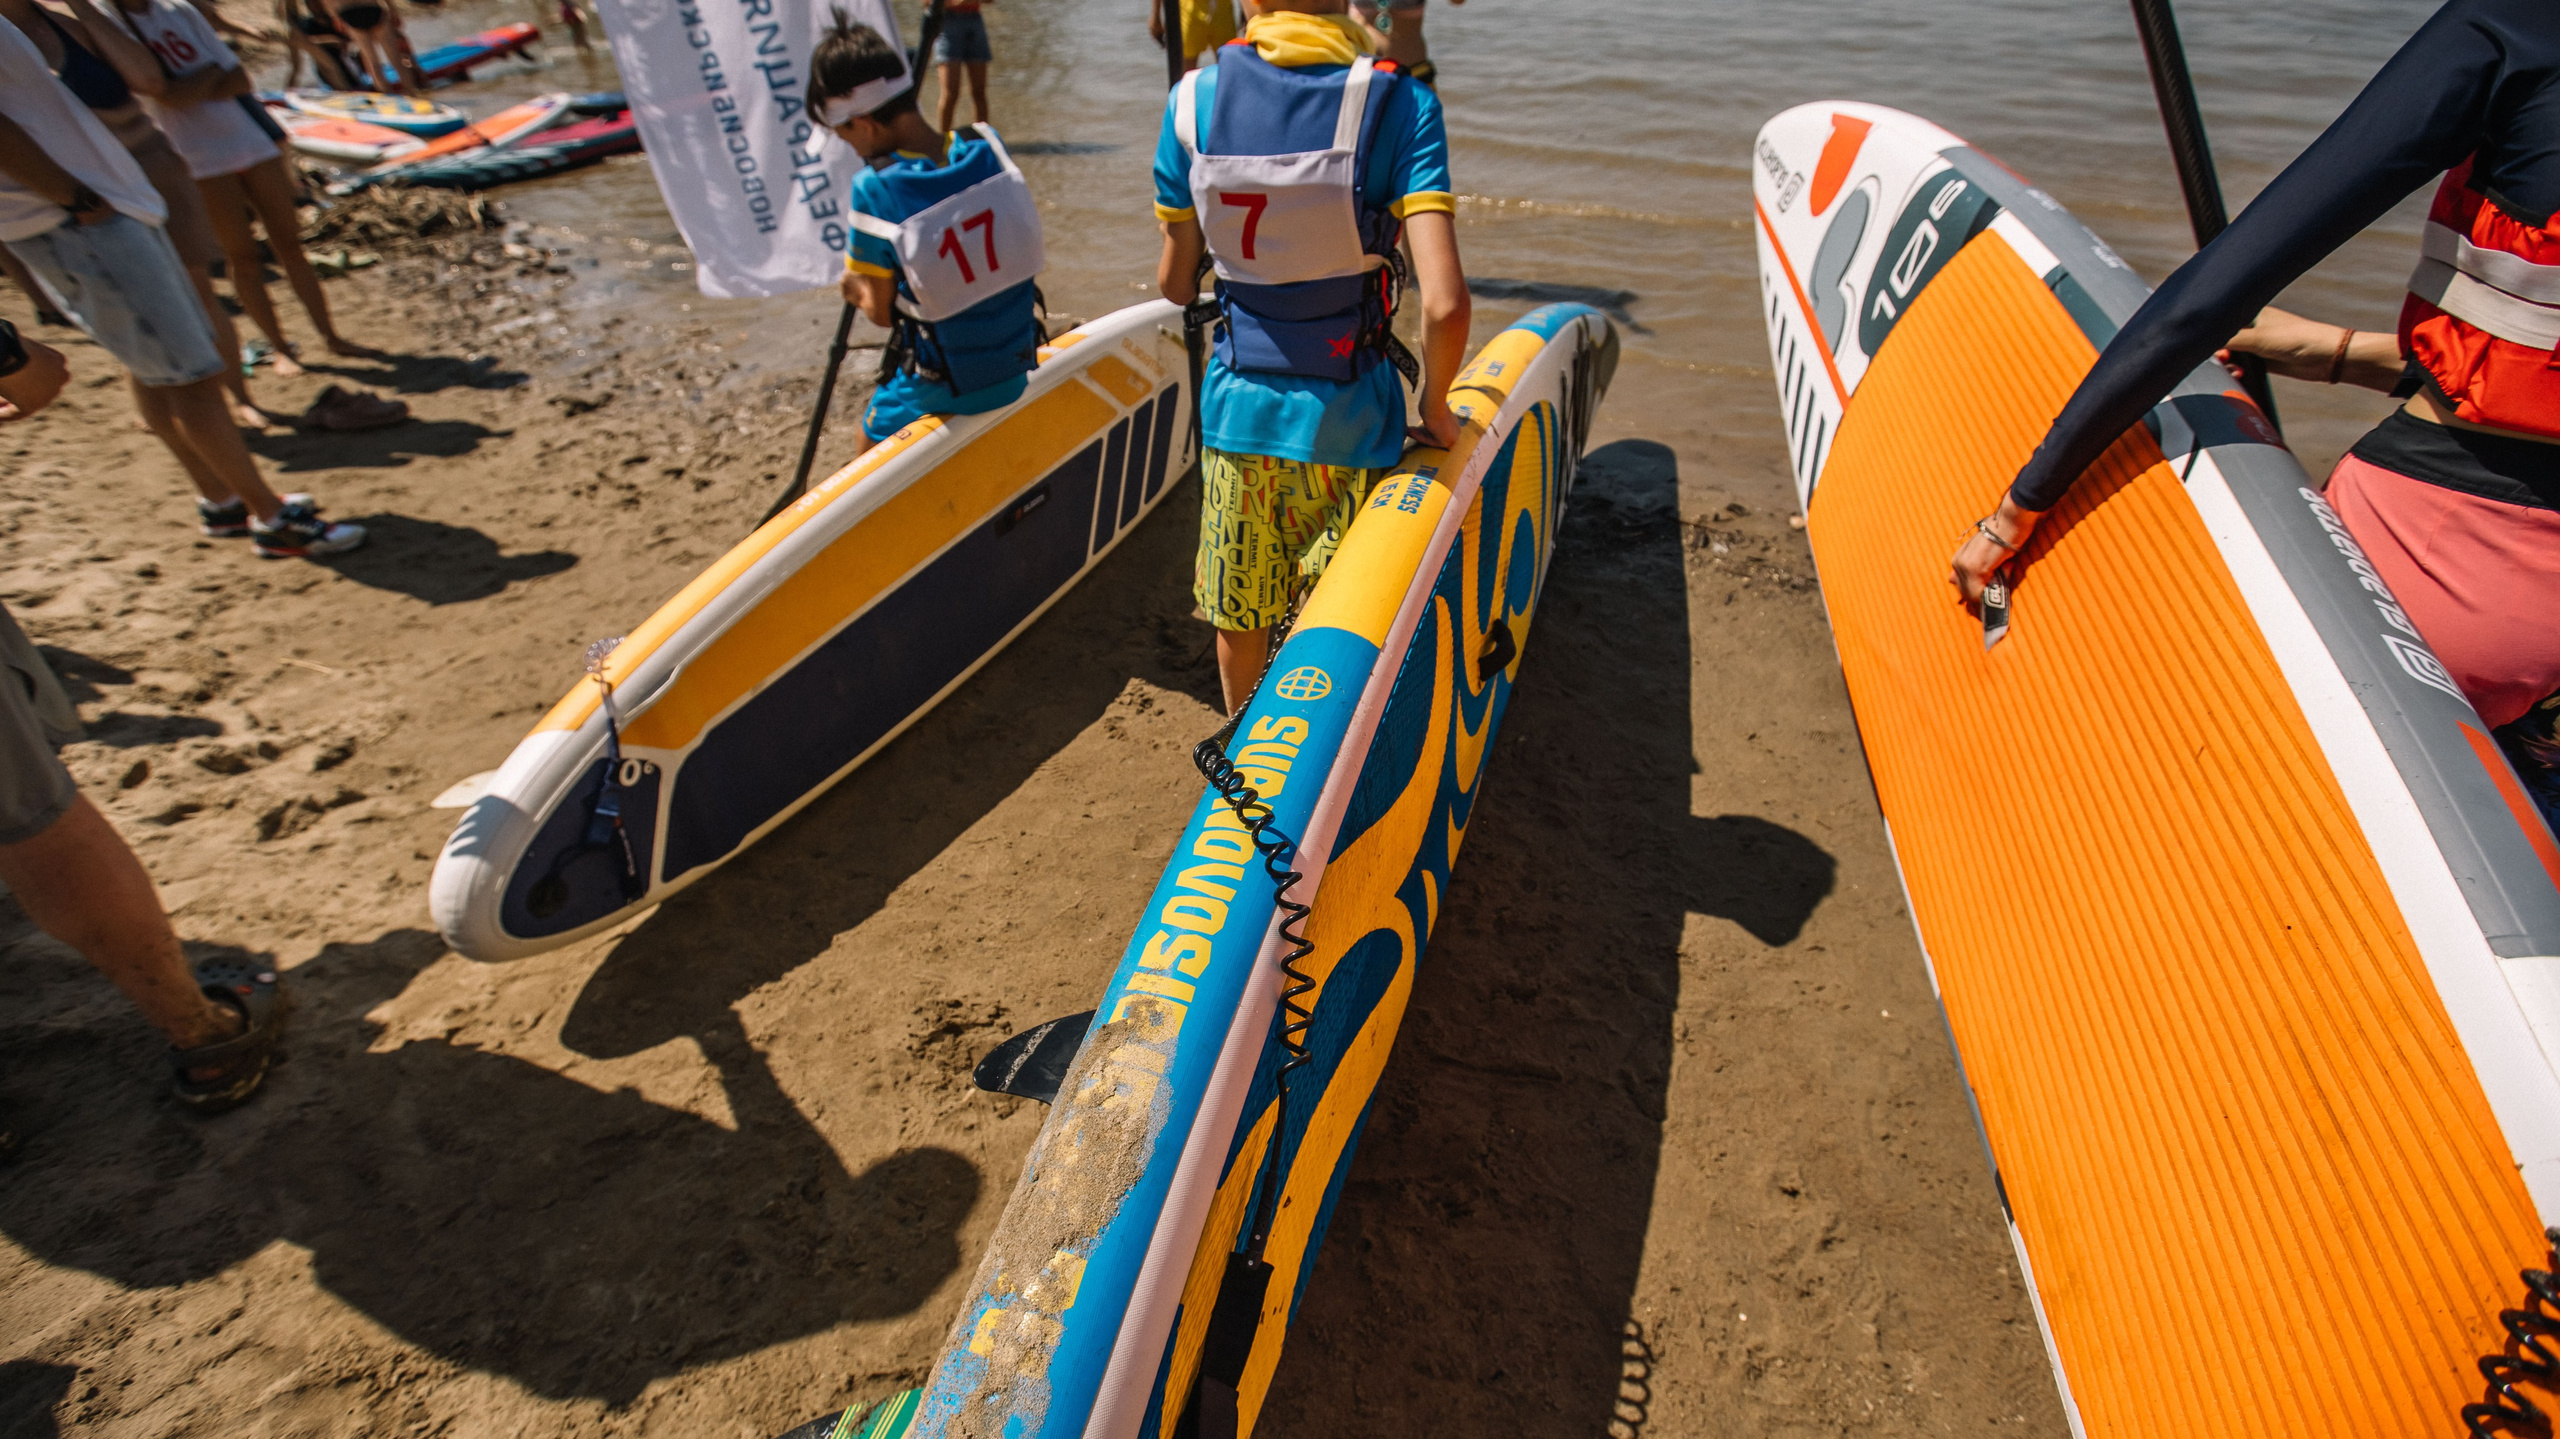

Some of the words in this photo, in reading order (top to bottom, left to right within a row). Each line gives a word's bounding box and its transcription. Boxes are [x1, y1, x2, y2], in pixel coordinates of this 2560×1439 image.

[937, 207, 1001, 285] 17
[1219, 192, 1269, 261] 7
[1229, 471, 1238, 512] TERMIT
[1251, 532, 1259, 570] TERMIT
[2298, 487, 2423, 642] GLADIATOR
[1258, 575, 1266, 610] TERMIT
